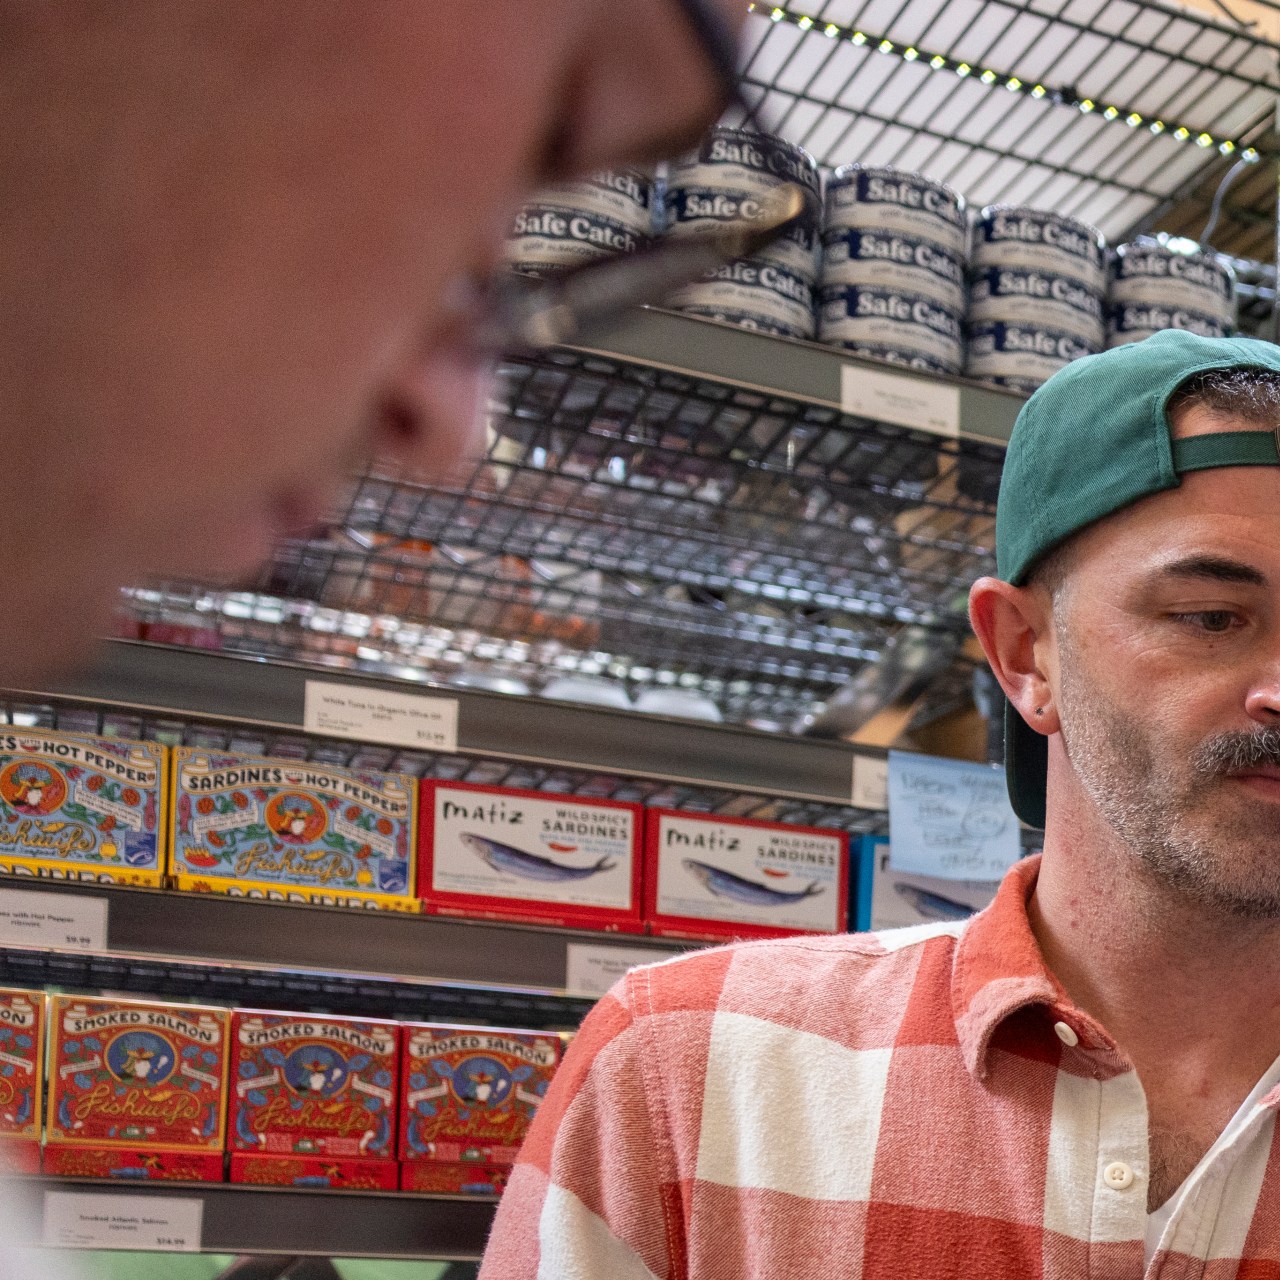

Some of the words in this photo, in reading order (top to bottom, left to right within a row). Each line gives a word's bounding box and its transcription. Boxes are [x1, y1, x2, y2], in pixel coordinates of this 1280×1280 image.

[710, 139, 763, 169] Safe
[592, 170, 640, 202] atch
[866, 178, 921, 206] Safe
[923, 190, 961, 222] Cat
[686, 195, 737, 217] Safe
[515, 212, 566, 236] Safe
[570, 217, 636, 252] Catch
[992, 215, 1041, 240] Safe
[858, 234, 913, 262] Safe
[1122, 254, 1167, 276] Safe
[998, 271, 1049, 297] Safe
[857, 292, 910, 319] Safe
[1123, 307, 1170, 330] Safe
[1004, 327, 1056, 352] Safe
[43, 741, 81, 759] HOT
[84, 750, 148, 783] PEPPER
[188, 768, 283, 790] SARDINES
[306, 774, 339, 790] HOT
[343, 781, 400, 813] PEPPER
[0, 819, 96, 858] shwife
[542, 818, 629, 840] SARDINES
[235, 842, 353, 884] Fishwife
[757, 845, 836, 866] SARDINES
[74, 1010, 141, 1032] SMOKED
[147, 1013, 212, 1043] SALMON
[248, 1023, 314, 1045] SMOKED
[321, 1025, 386, 1054] SALMON
[418, 1035, 481, 1057] SMOKED
[487, 1037, 548, 1064] SALMON
[75, 1085, 200, 1126] Fishwife
[423, 1107, 527, 1147] Fishwif
